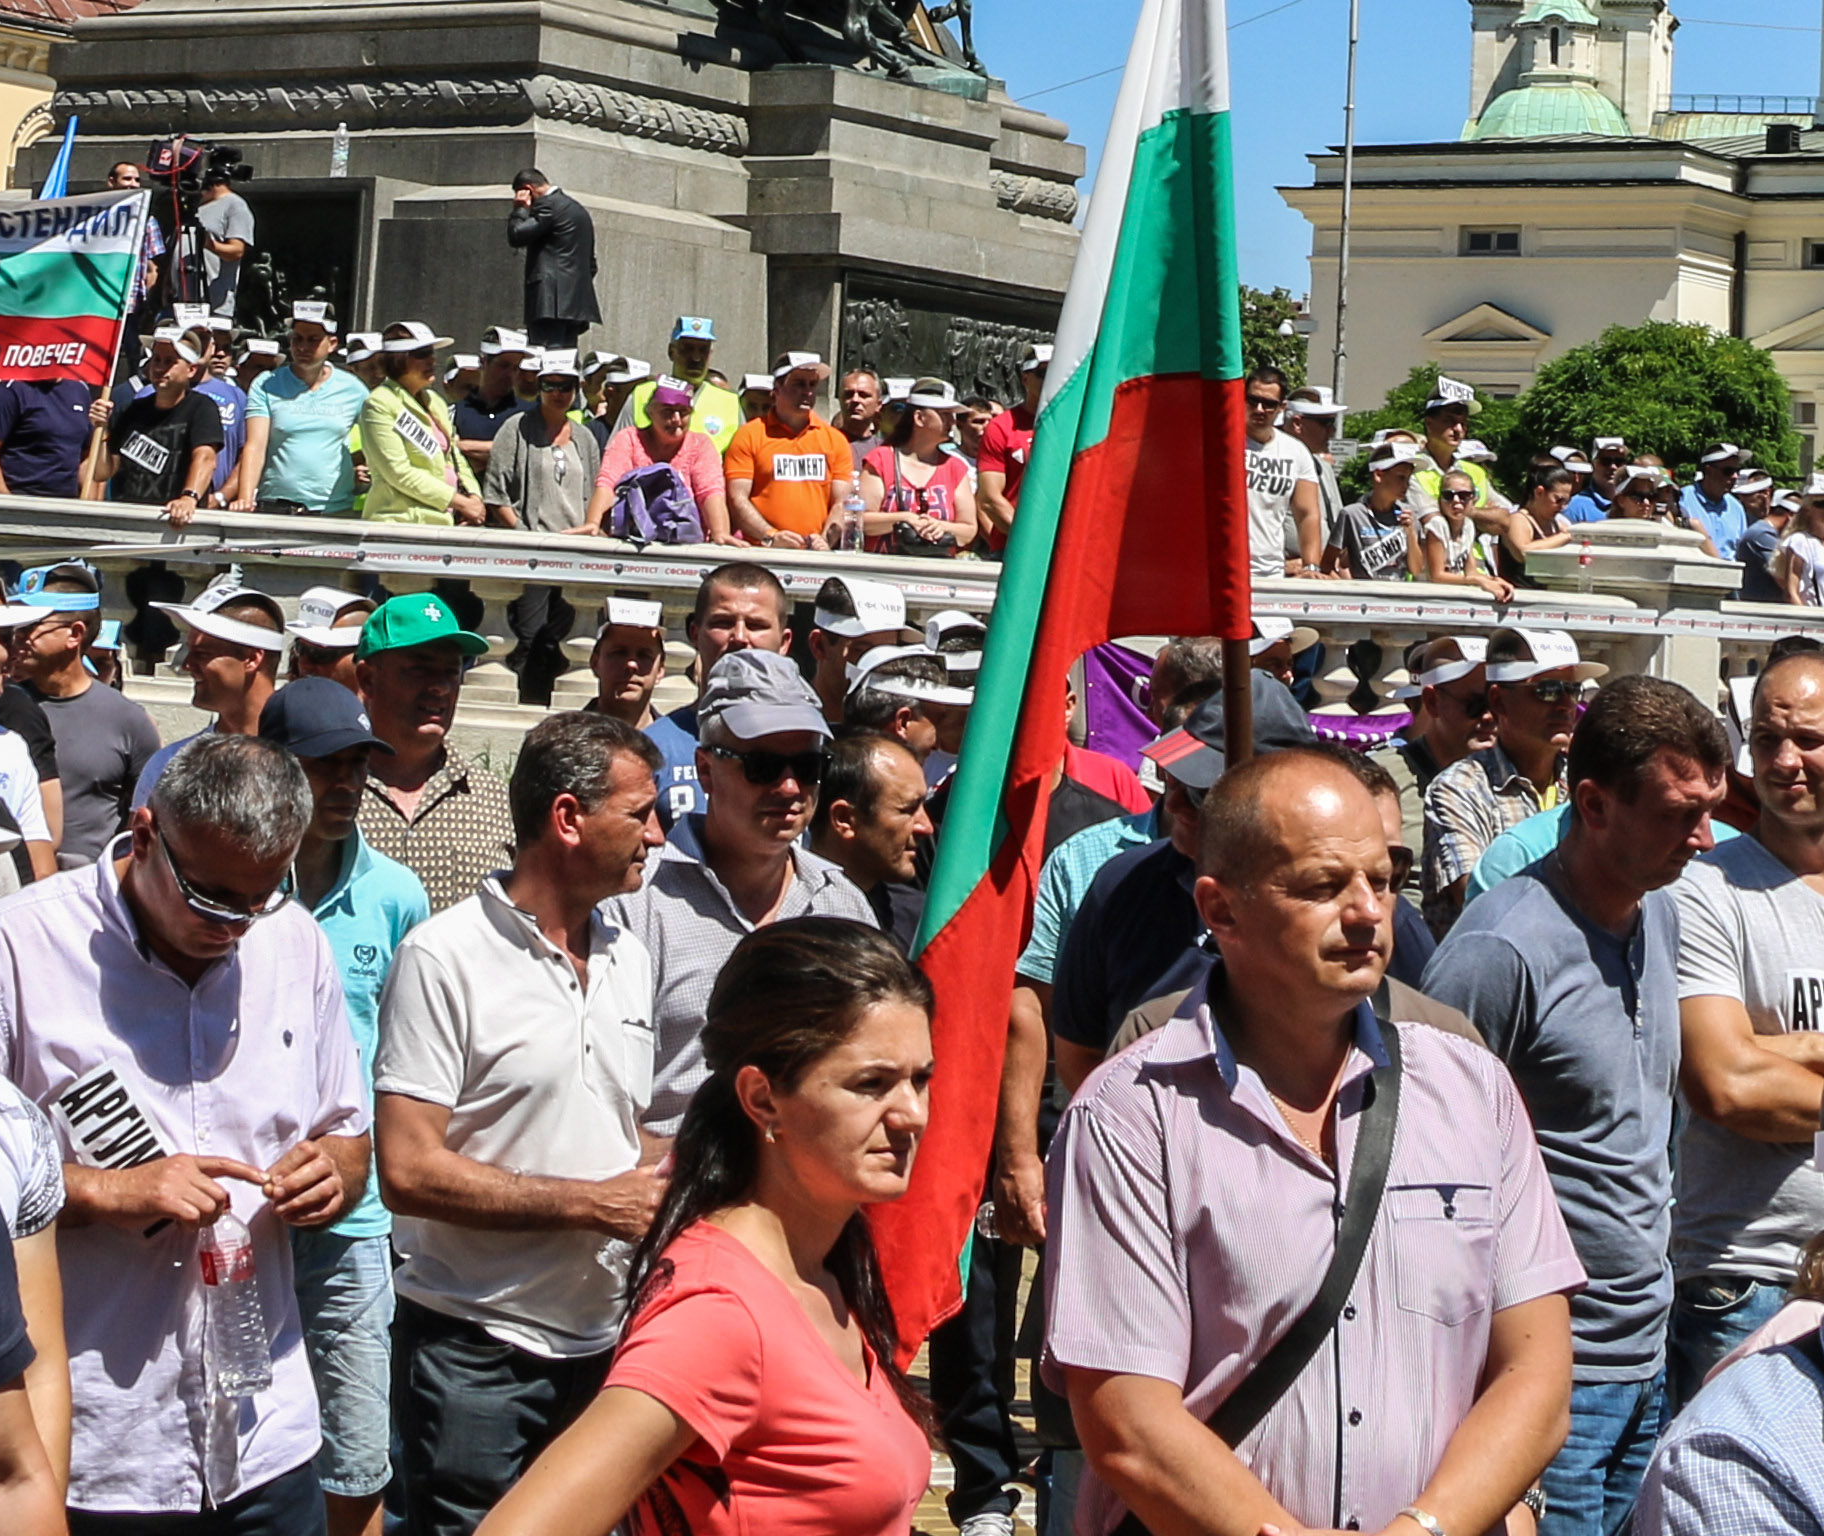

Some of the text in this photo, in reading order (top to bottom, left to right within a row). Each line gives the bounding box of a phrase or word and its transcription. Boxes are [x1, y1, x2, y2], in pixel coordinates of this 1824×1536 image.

[2, 342, 87, 368] ПОВЕЧЕ!
[396, 410, 438, 457] АРГУМЕНТ
[775, 457, 826, 481] АРГУМЕНТ
[1269, 476, 1293, 497] UP
[452, 556, 488, 565] ПРОТЕСТ
[493, 557, 528, 566] СФСМВР
[579, 562, 614, 571] СФСМВР
